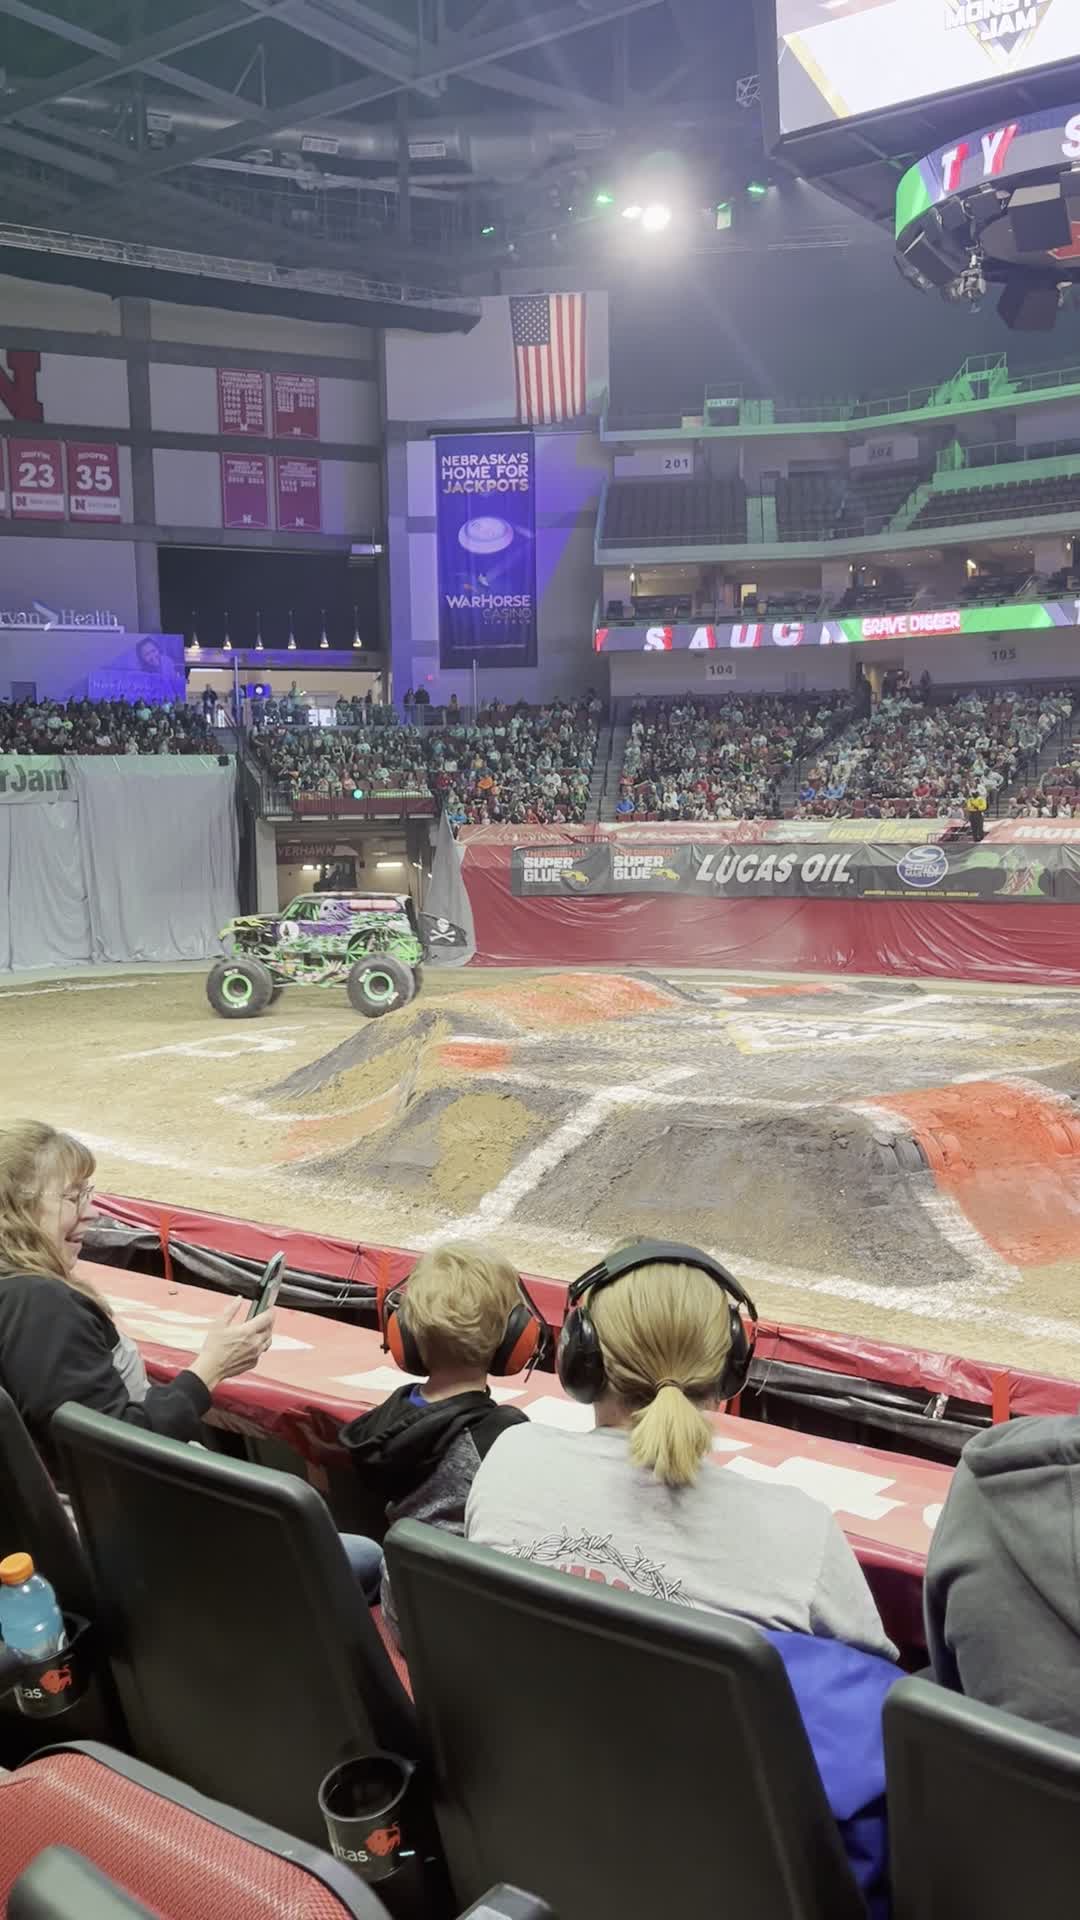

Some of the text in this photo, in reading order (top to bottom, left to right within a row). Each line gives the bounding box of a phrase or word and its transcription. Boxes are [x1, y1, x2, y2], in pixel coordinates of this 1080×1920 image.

[980, 7, 1037, 41] JAM
[441, 452, 529, 467] NEBRASKA'S
[664, 458, 689, 470] 201
[18, 462, 56, 489] 23
[76, 464, 113, 492] 35
[441, 464, 529, 480] HOME FOR
[443, 478, 529, 494] JACKPOTS
[445, 594, 532, 608] WARHORSE
[61, 609, 119, 627] Health
[482, 608, 532, 619] CASINO
[862, 616, 906, 636] GRAVE
[910, 611, 961, 632] DIGGER
[709, 664, 733, 676] 104
[523, 857, 574, 869] SUPER
[613, 855, 664, 868] SUPER
[696, 853, 798, 884] LUCAS
[904, 863, 940, 873] SPIN
[523, 869, 561, 882] GLUE
[613, 867, 651, 880] GLUE
